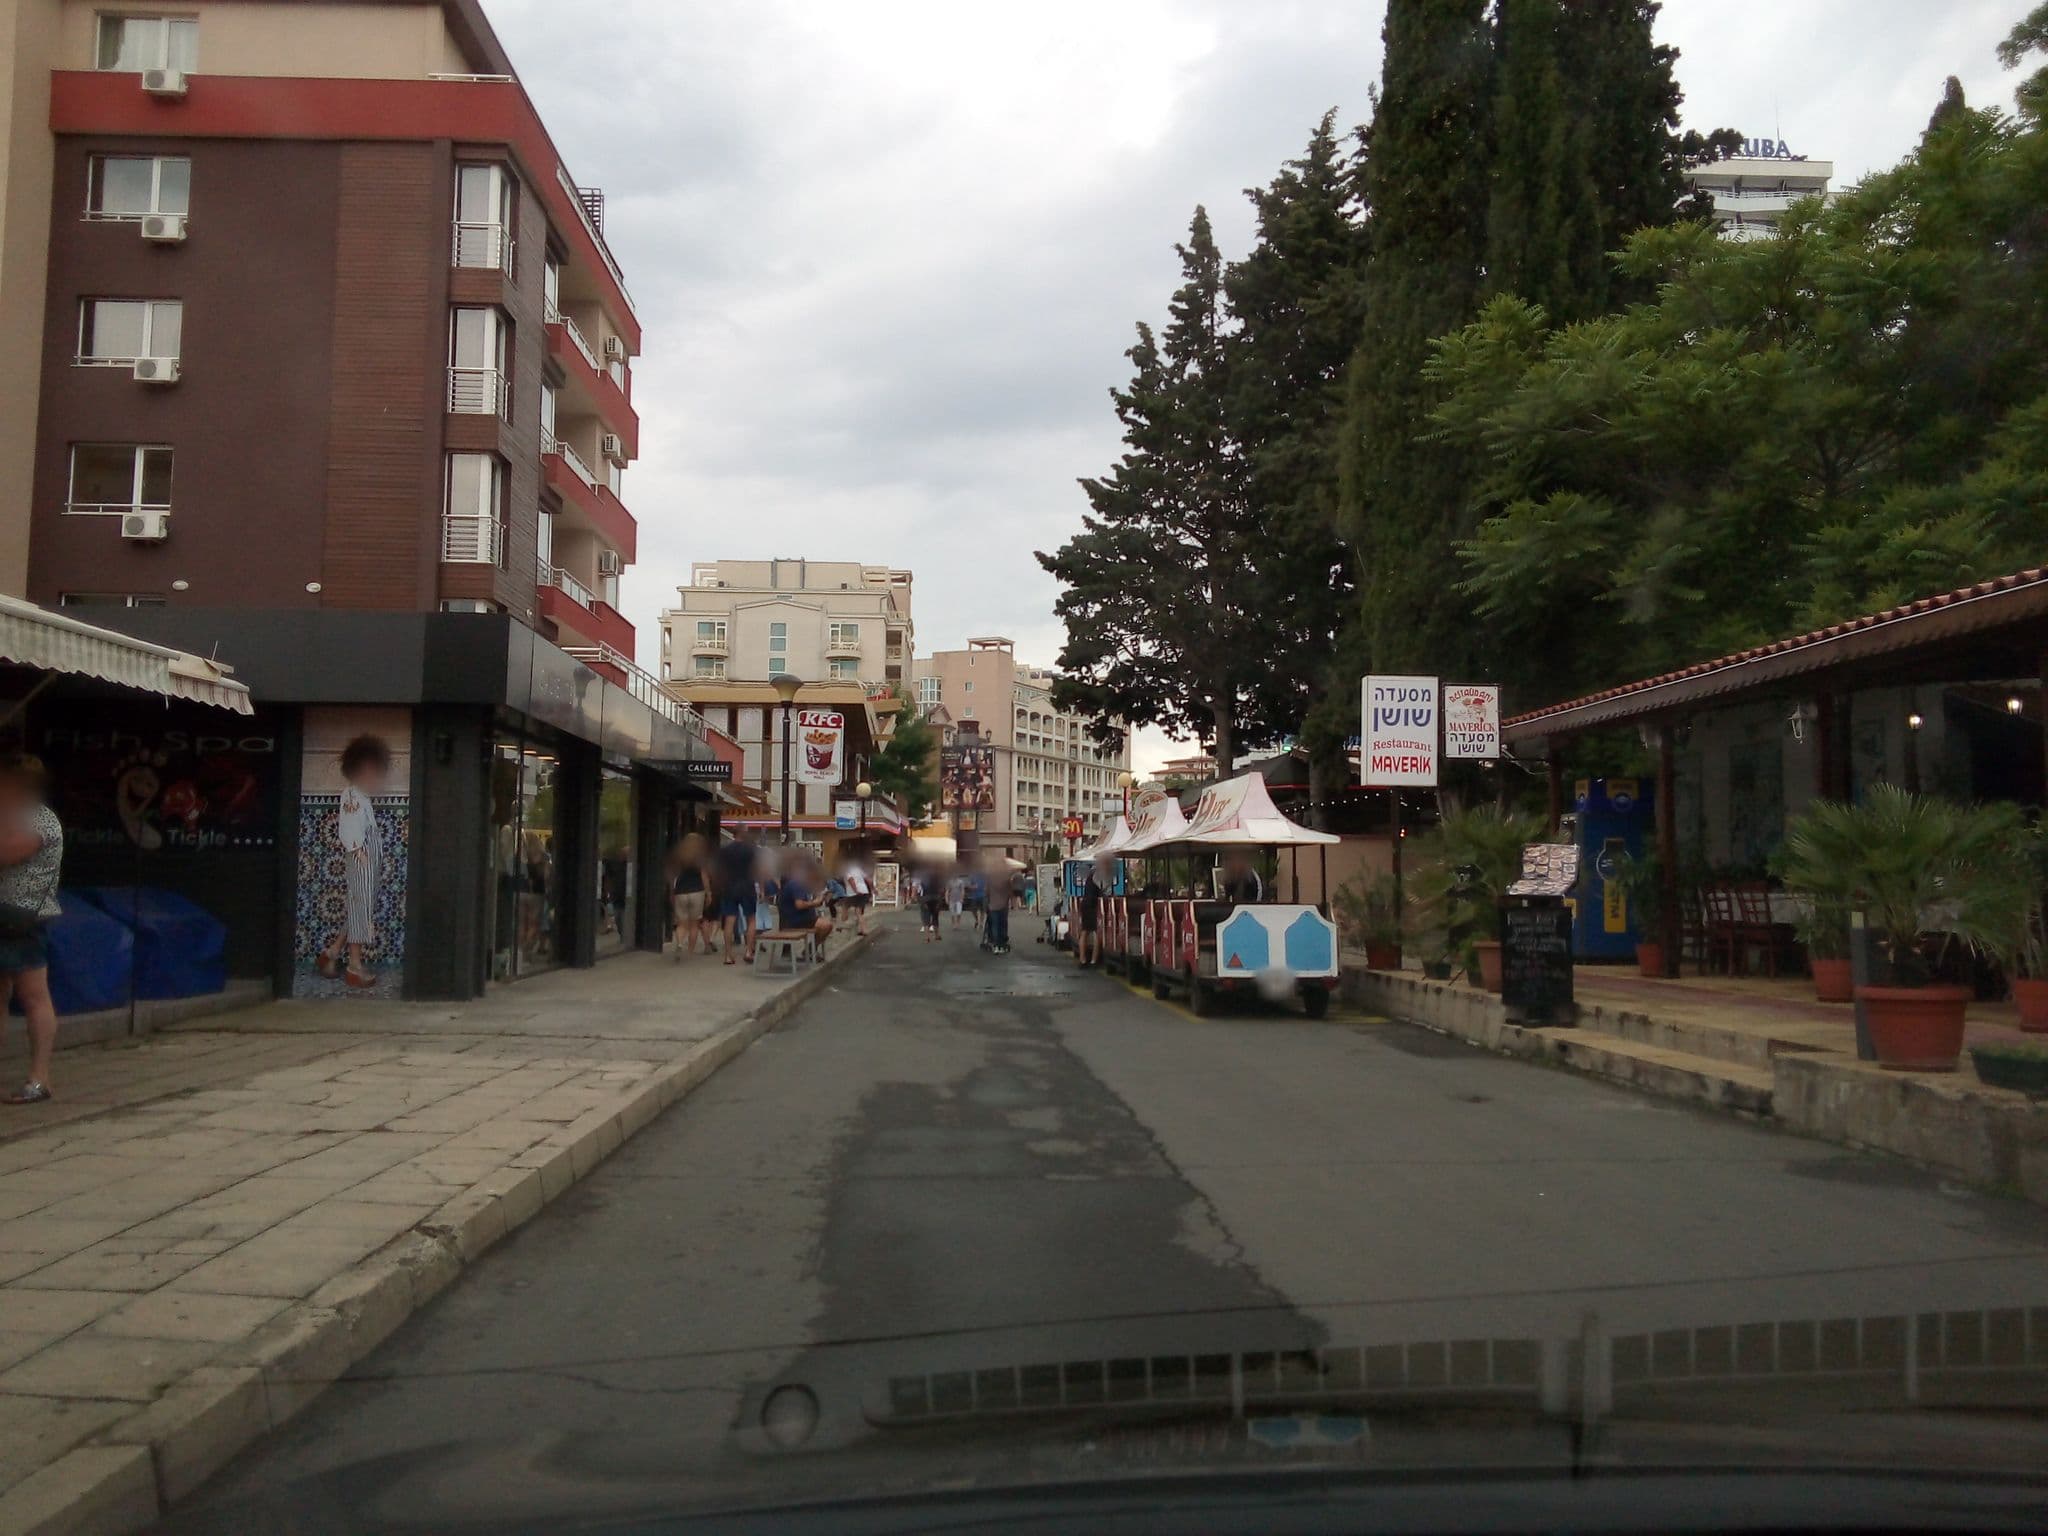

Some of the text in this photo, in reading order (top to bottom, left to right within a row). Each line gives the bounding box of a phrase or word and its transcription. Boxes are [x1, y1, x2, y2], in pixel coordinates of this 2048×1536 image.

[1374, 687, 1432, 703] מסעדה
[803, 713, 839, 727] KFC
[1373, 707, 1432, 733] שושן
[1449, 721, 1496, 733] MAVERICK
[43, 728, 275, 756] Fish Spa
[1450, 732, 1495, 744] מסעדה
[1373, 738, 1432, 753] Restaurant
[1458, 743, 1486, 756] שושן
[687, 764, 730, 773] CALIENTE
[1372, 754, 1432, 776] MAVERIK
